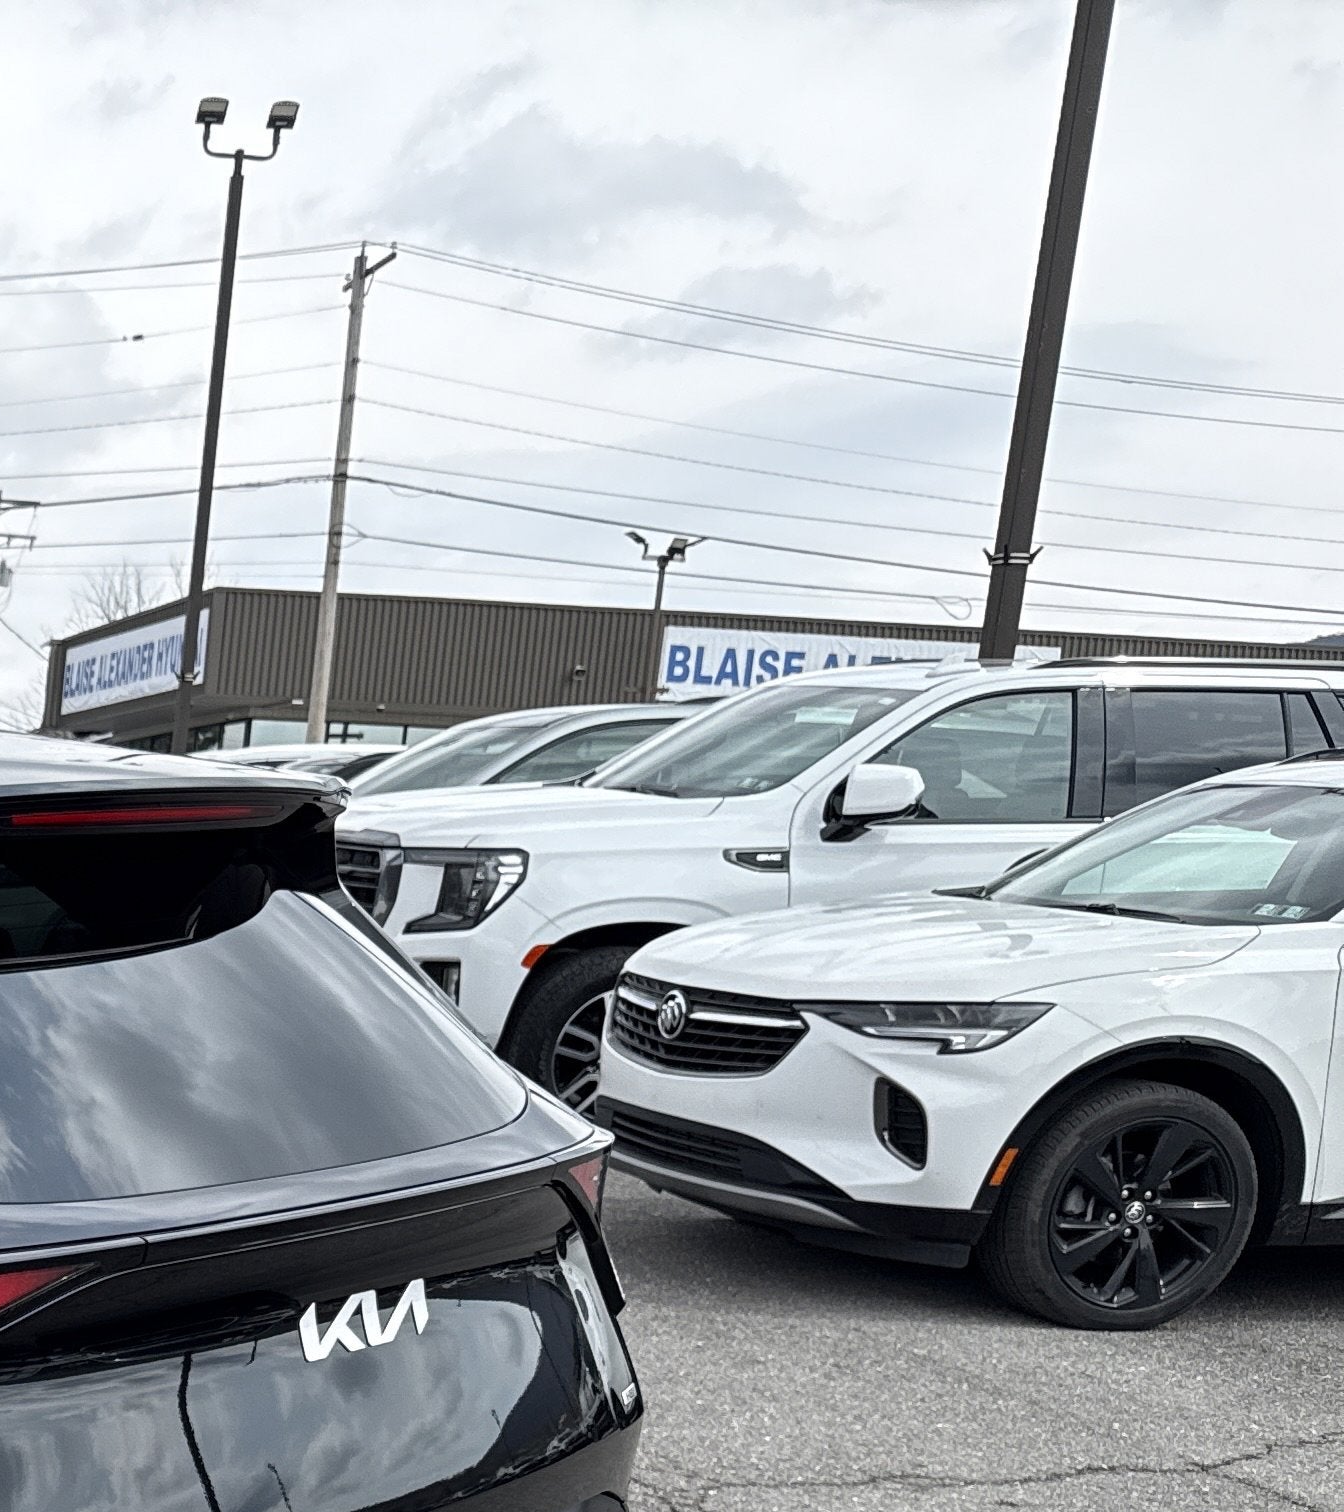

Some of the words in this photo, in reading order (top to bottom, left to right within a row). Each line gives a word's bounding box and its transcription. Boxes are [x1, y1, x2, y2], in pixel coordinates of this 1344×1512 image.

[63, 656, 97, 699] BLAISE
[95, 641, 155, 691] ALEXANDER
[155, 627, 204, 678] HYUI
[665, 644, 806, 688] BLAISE
[298, 1277, 429, 1363] KIA
